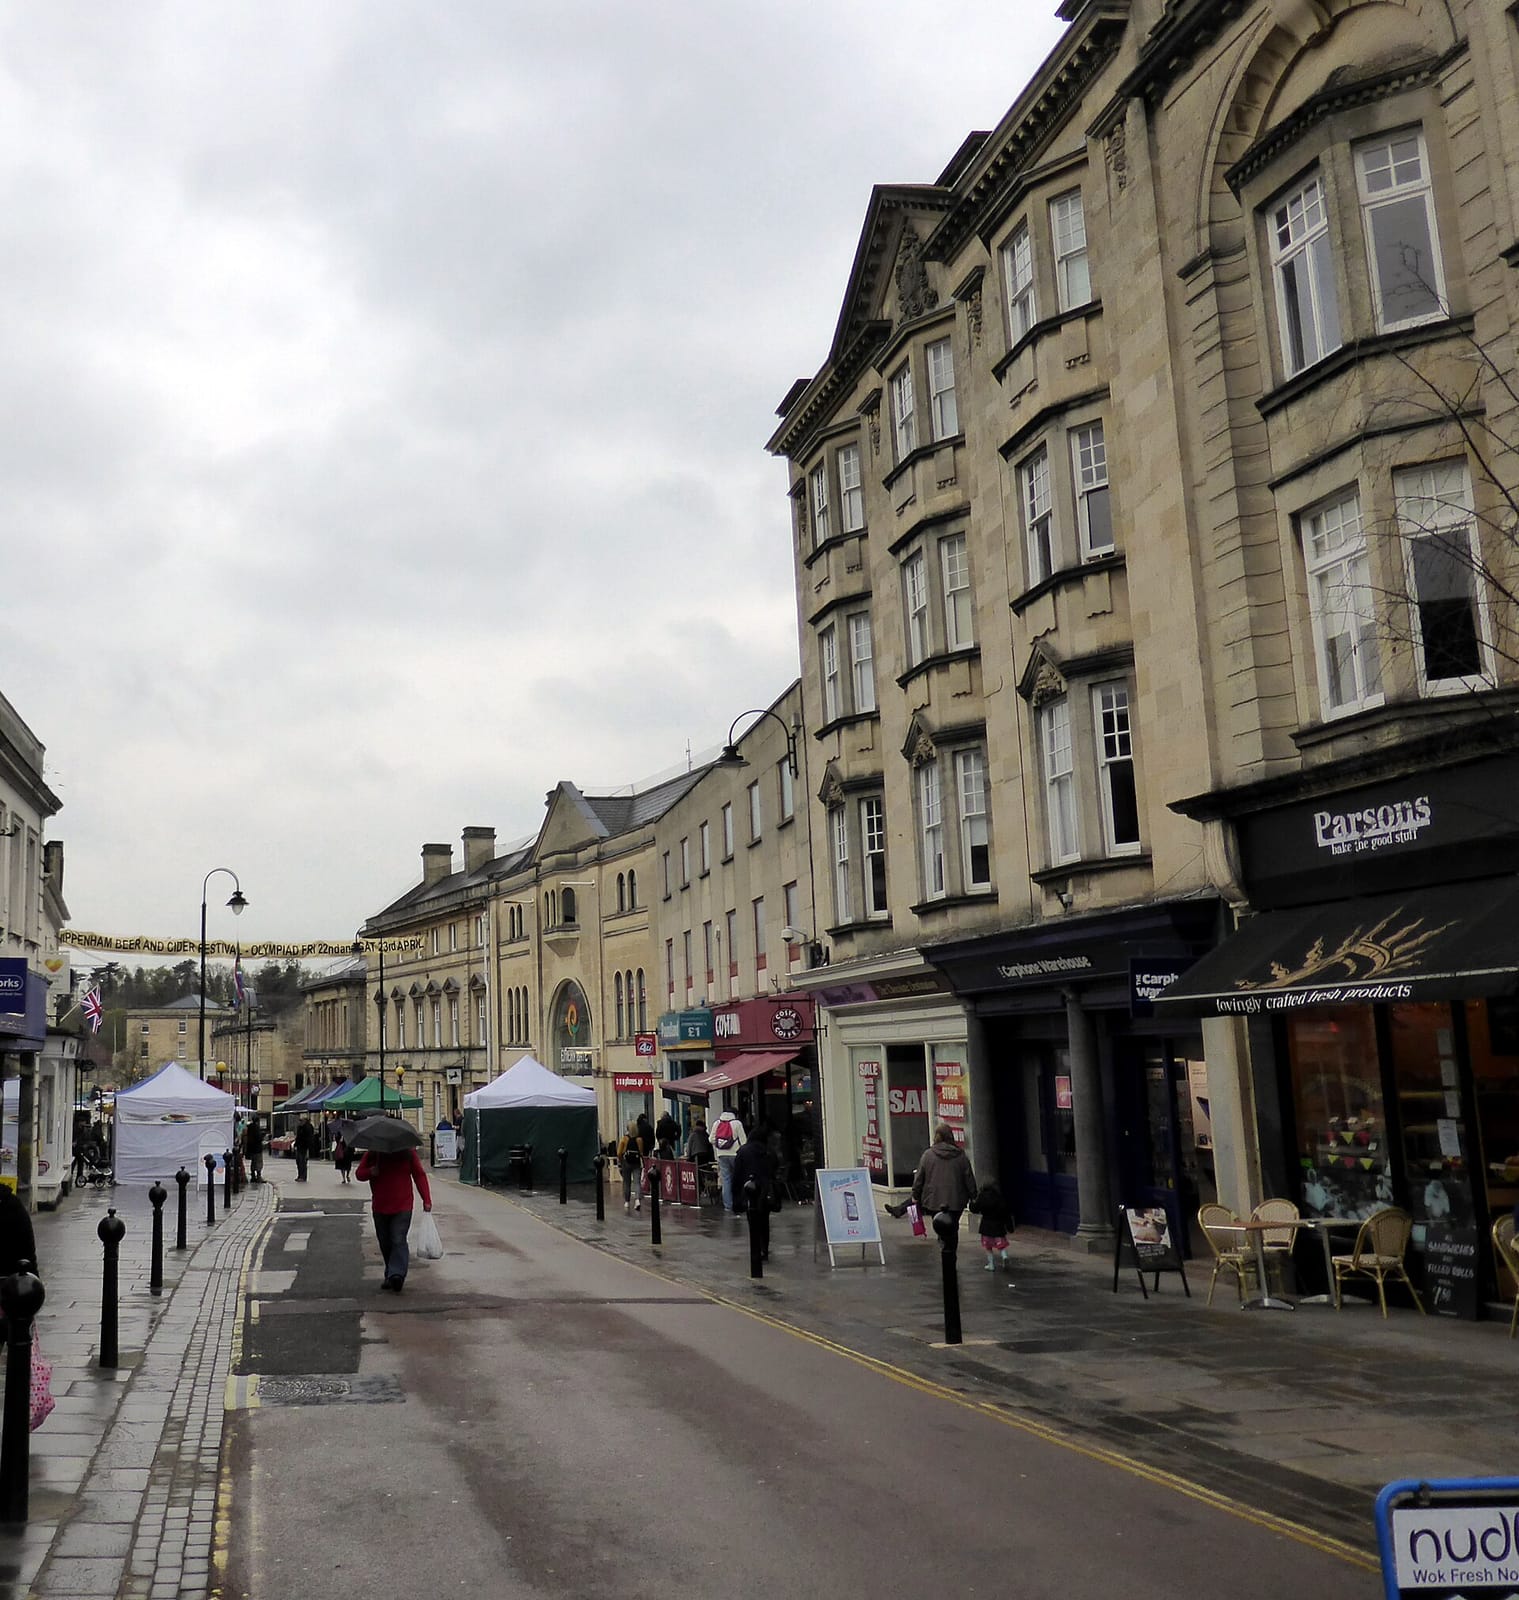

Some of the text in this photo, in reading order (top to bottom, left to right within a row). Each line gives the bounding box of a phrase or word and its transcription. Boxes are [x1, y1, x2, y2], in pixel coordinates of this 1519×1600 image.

[1314, 796, 1431, 847] Parsons
[1371, 832, 1393, 851] good
[115, 938, 141, 950] BEER
[143, 940, 164, 952] AND
[167, 940, 194, 953] CIDER
[251, 944, 299, 956] OLYMPIAD
[302, 943, 316, 956] FRI
[1216, 984, 1413, 1013] lovingly crafted fresh products
[860, 1063, 879, 1076] SALE
[1413, 1568, 1519, 1583] Wok Fresh No
